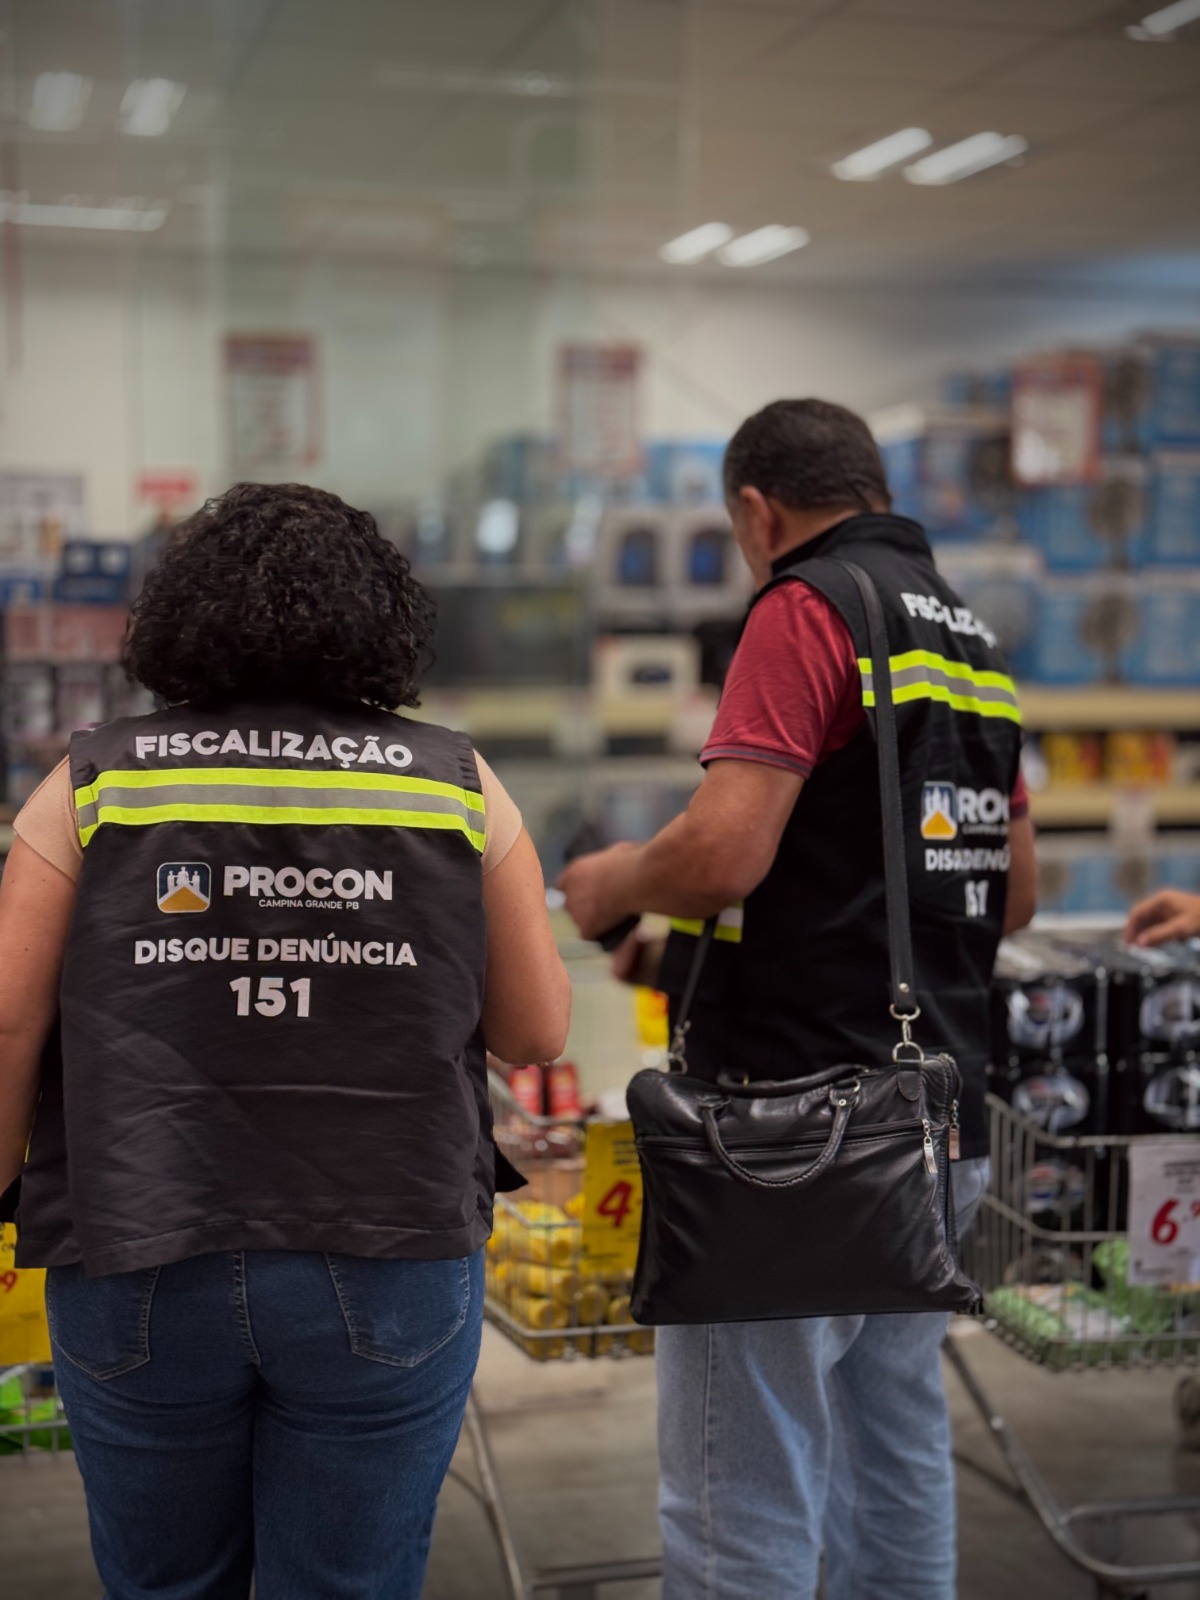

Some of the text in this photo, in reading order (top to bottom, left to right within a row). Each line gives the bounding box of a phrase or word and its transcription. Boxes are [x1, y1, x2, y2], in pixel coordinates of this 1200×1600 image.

[135, 729, 413, 768] FISCALIZAÇÃO
[223, 865, 393, 900] PROCON
[258, 898, 359, 910] CAMPINA GRANDE PB
[134, 932, 418, 966] DISQUE DENÚNCIA
[229, 976, 311, 1018] 151
